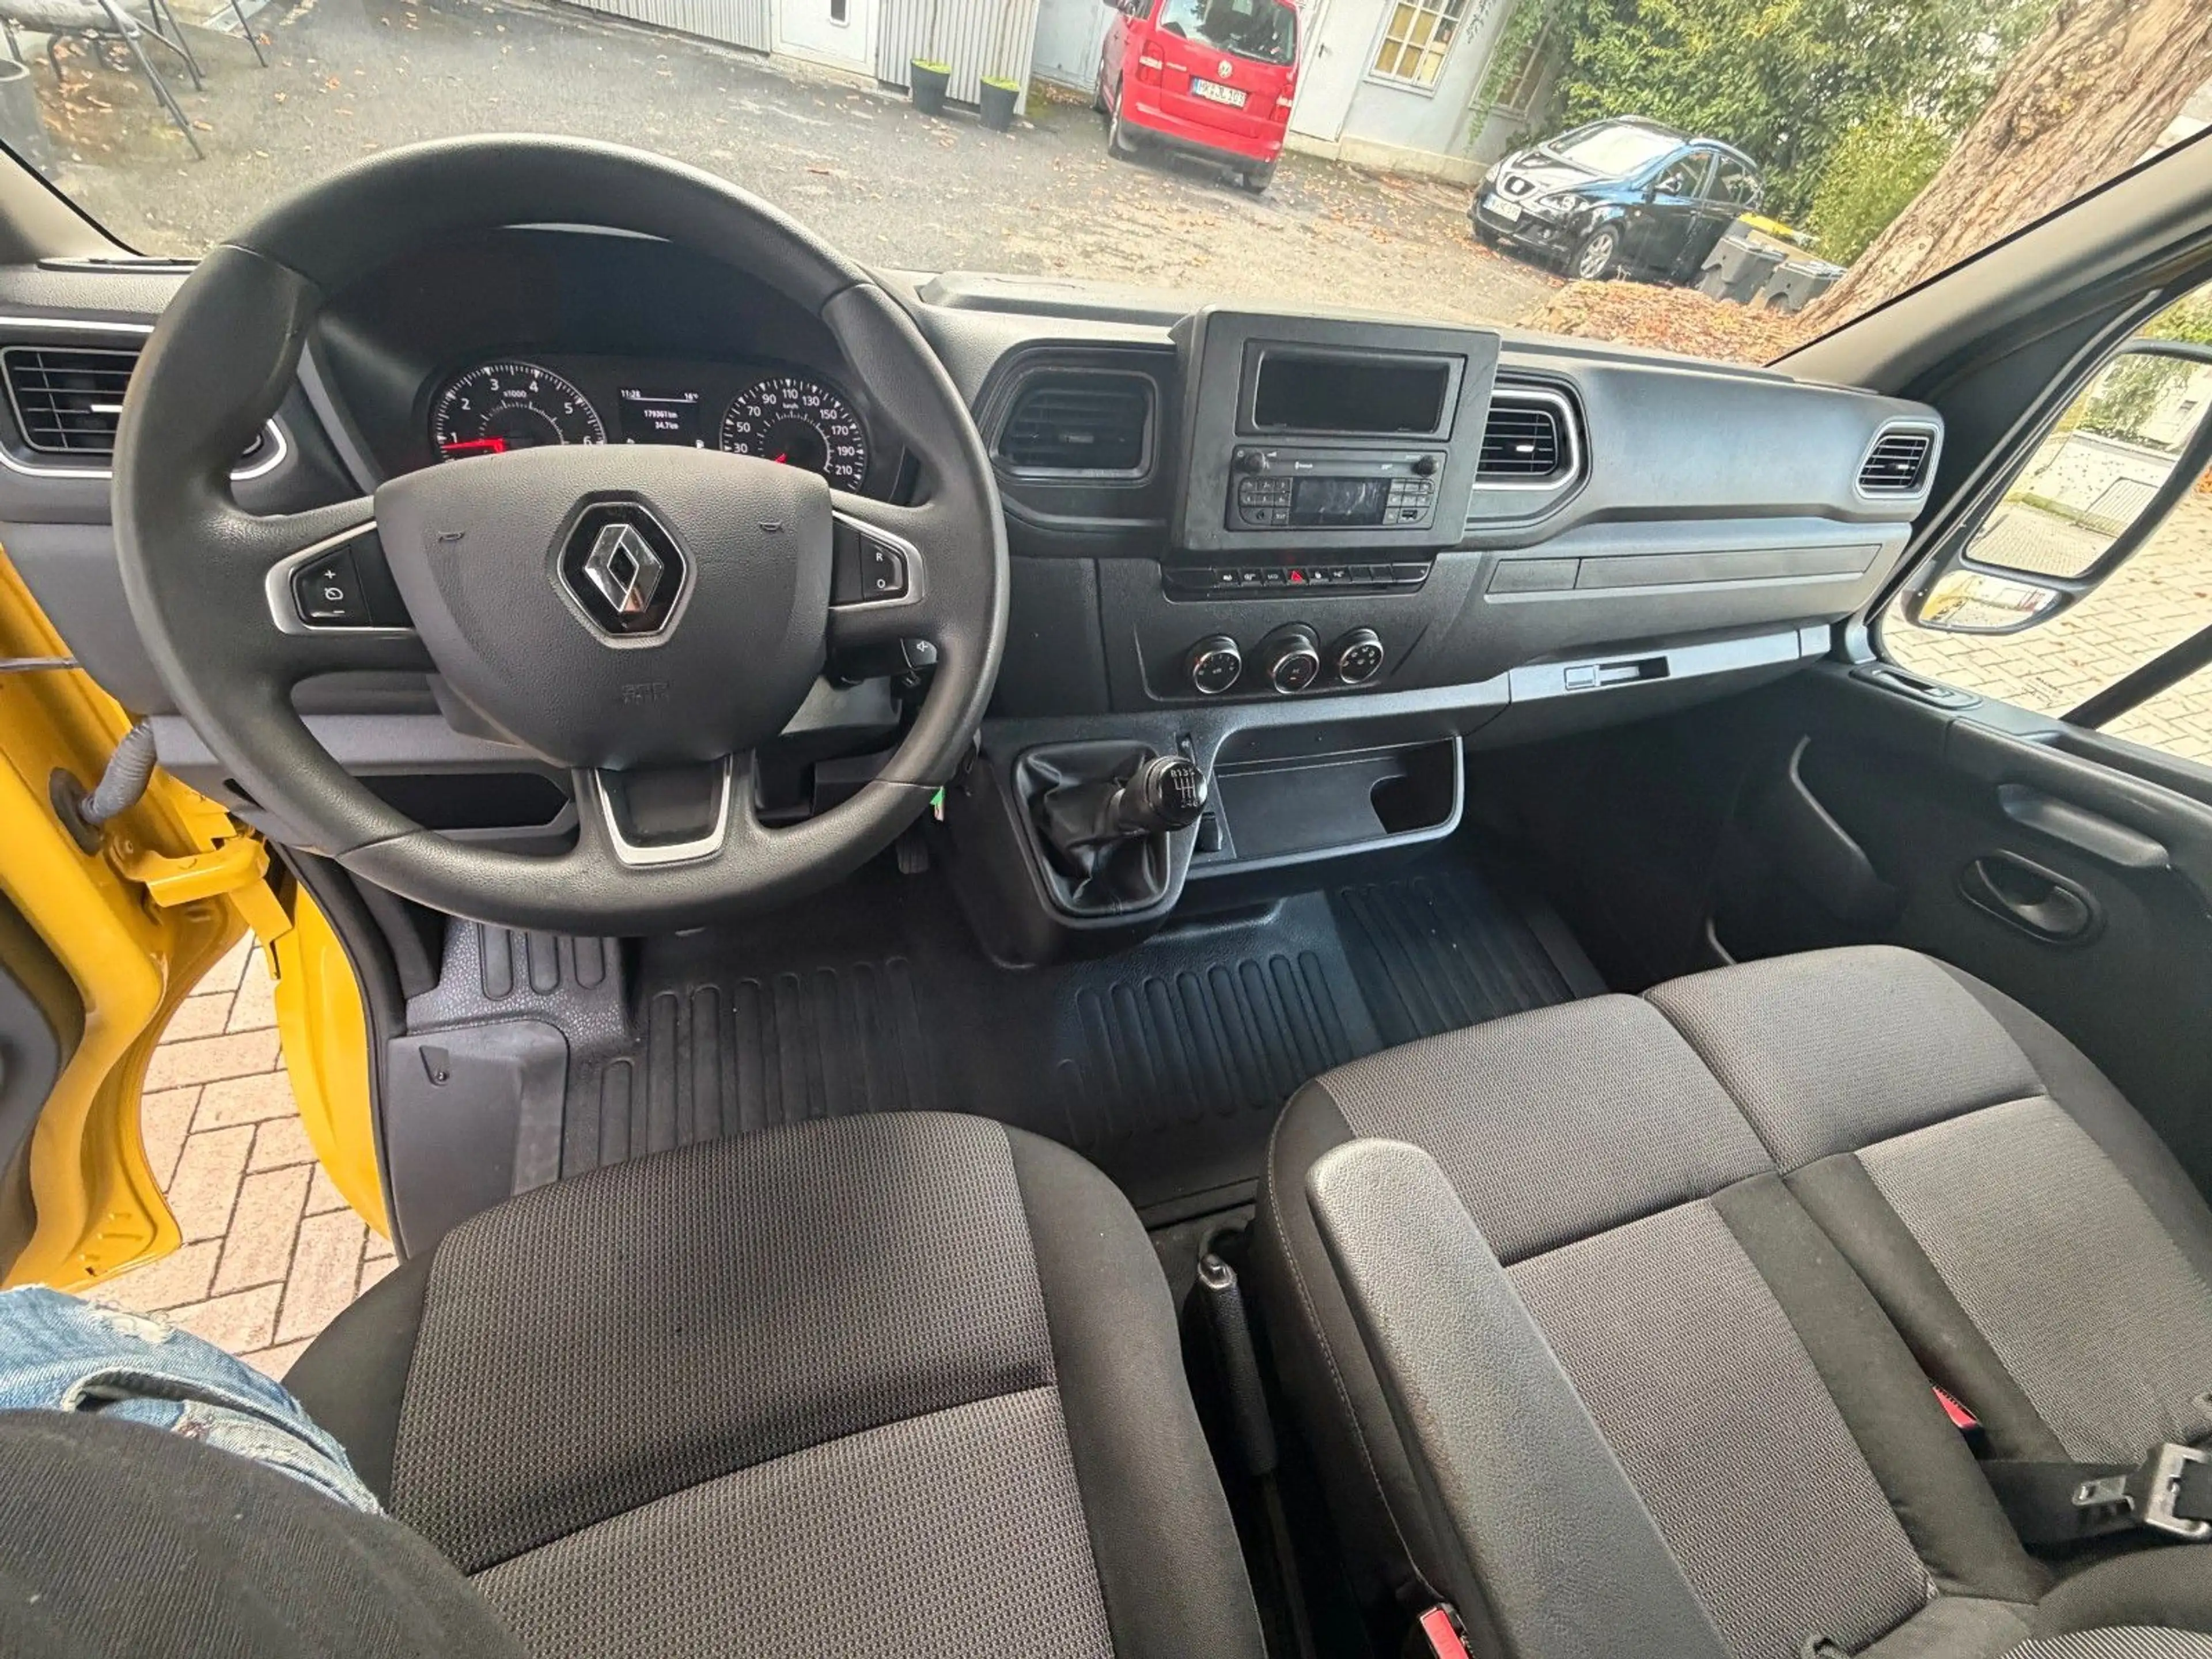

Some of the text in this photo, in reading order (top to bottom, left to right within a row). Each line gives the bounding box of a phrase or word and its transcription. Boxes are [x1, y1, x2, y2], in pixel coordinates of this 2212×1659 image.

[491, 379, 499, 391] 3
[529, 381, 539, 393] 4
[762, 394, 777, 404] 90
[782, 389, 798, 399] 110
[461, 398, 471, 410] 2
[802, 396, 820, 407] 130
[564, 403, 573, 415] 5
[747, 406, 761, 417] 70
[820, 409, 837, 420] 150
[737, 422, 750, 433] 50
[831, 426, 849, 436] 170
[450, 432, 457, 443] 1
[582, 435, 592, 445] 6
[733, 442, 748, 453] 30
[837, 446, 855, 456] 190
[835, 465, 853, 476] 210
[876, 552, 883, 562] R
